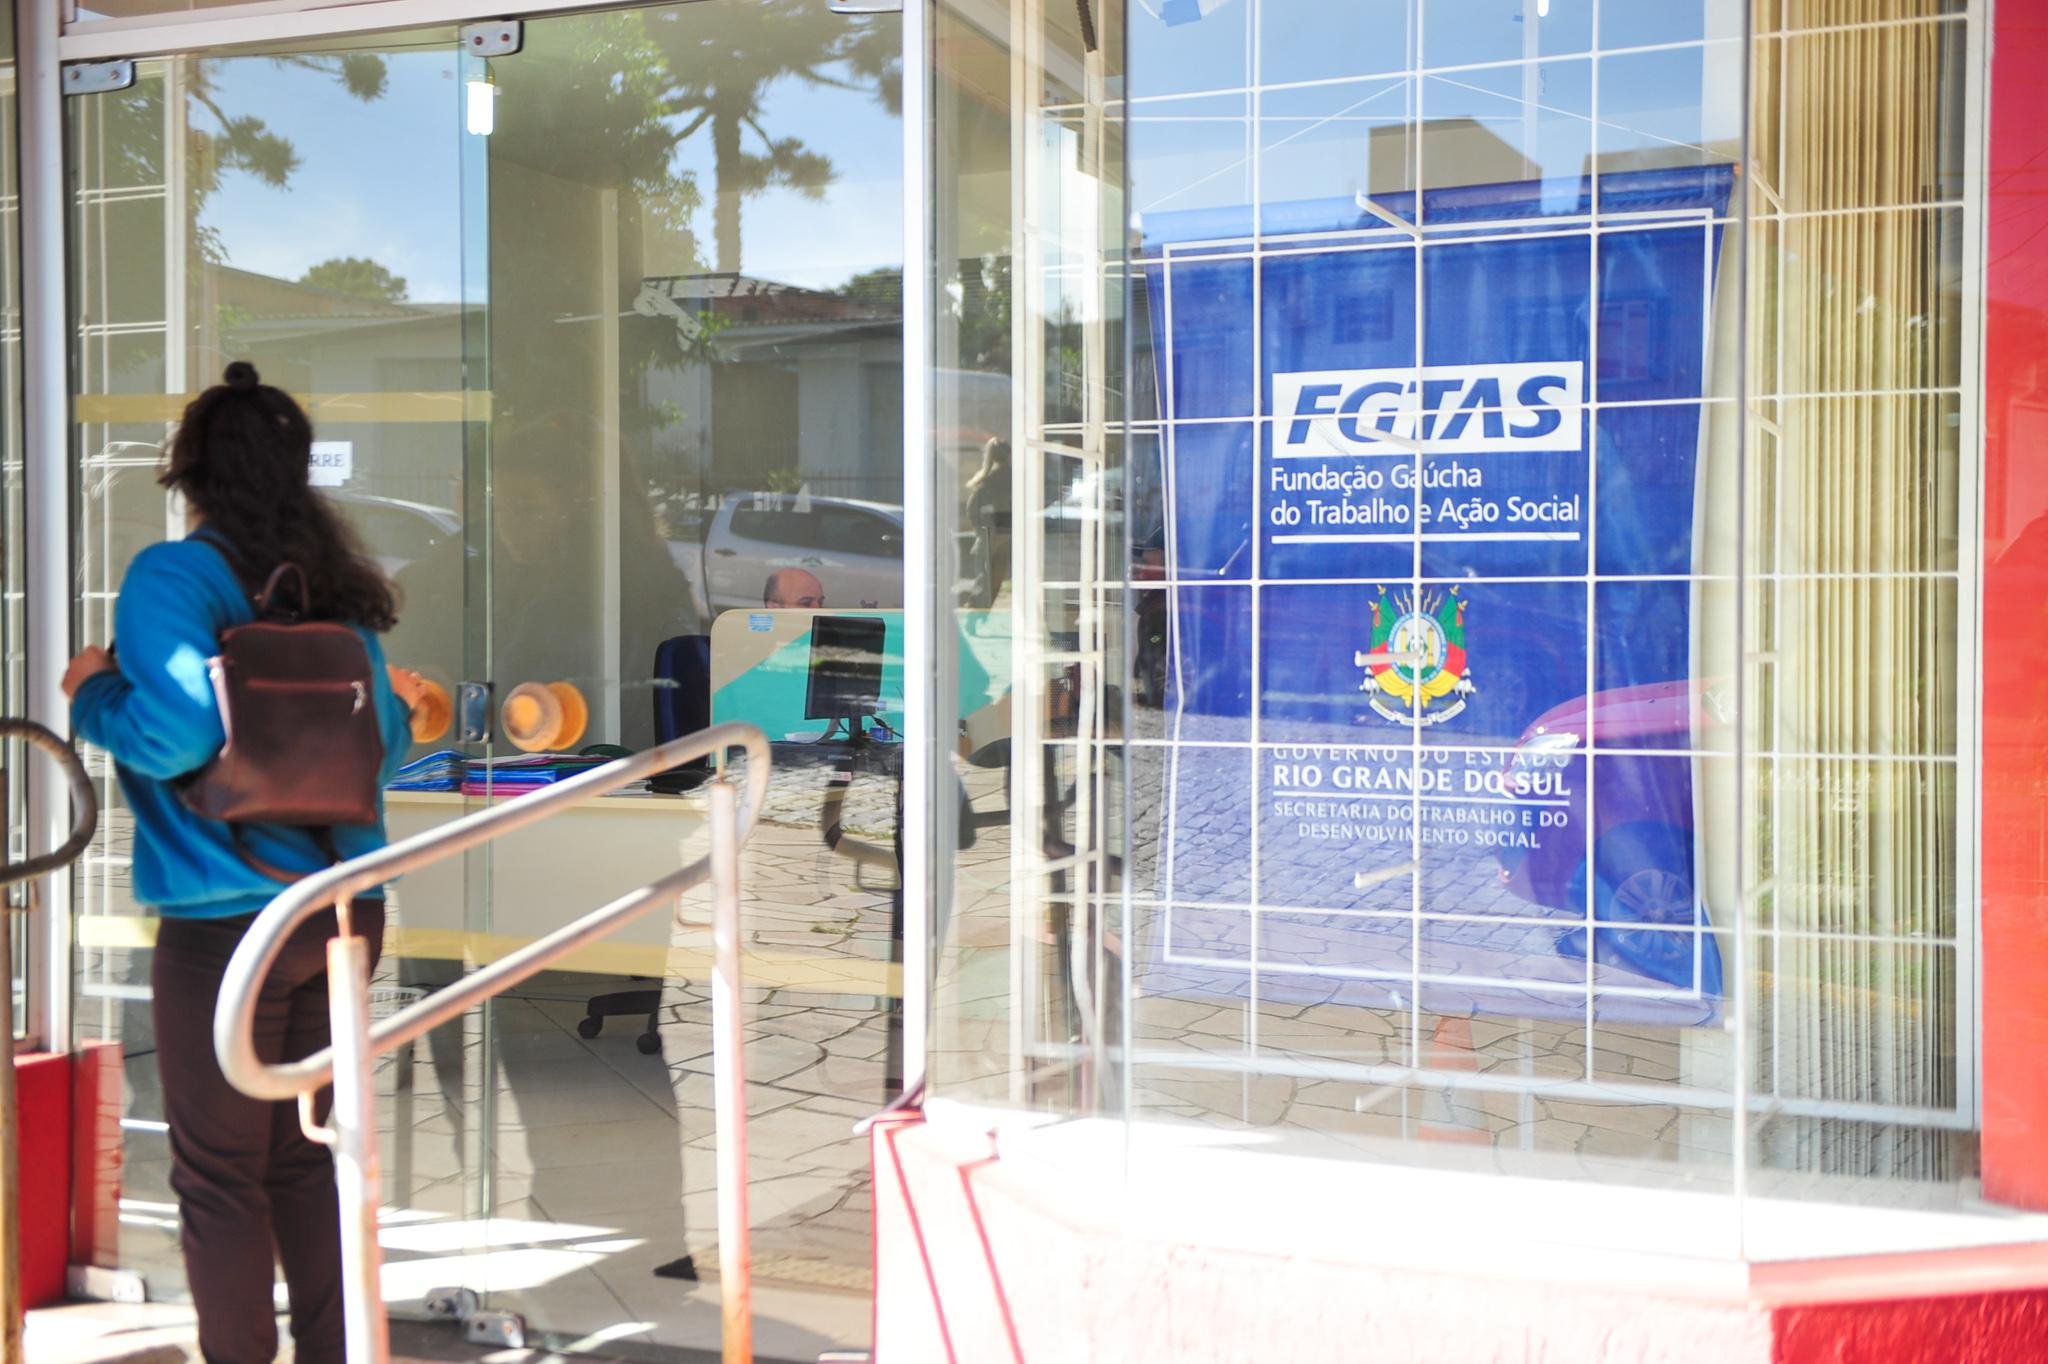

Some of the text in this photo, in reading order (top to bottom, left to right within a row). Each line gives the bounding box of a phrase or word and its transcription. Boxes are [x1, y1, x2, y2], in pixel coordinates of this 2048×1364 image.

[1287, 375, 1567, 444] FGTAS
[1271, 461, 1482, 496] Fundação Gaúcha
[1270, 494, 1580, 529] do Trabalho e Ação Social
[1273, 747, 1398, 763] GOVERNO
[1273, 764, 1571, 796] RIO GRANDE DO SUL
[1273, 801, 1569, 827] SECRETARIA DO TRABALHO E DO
[1475, 829, 1541, 848] SOCIAL
